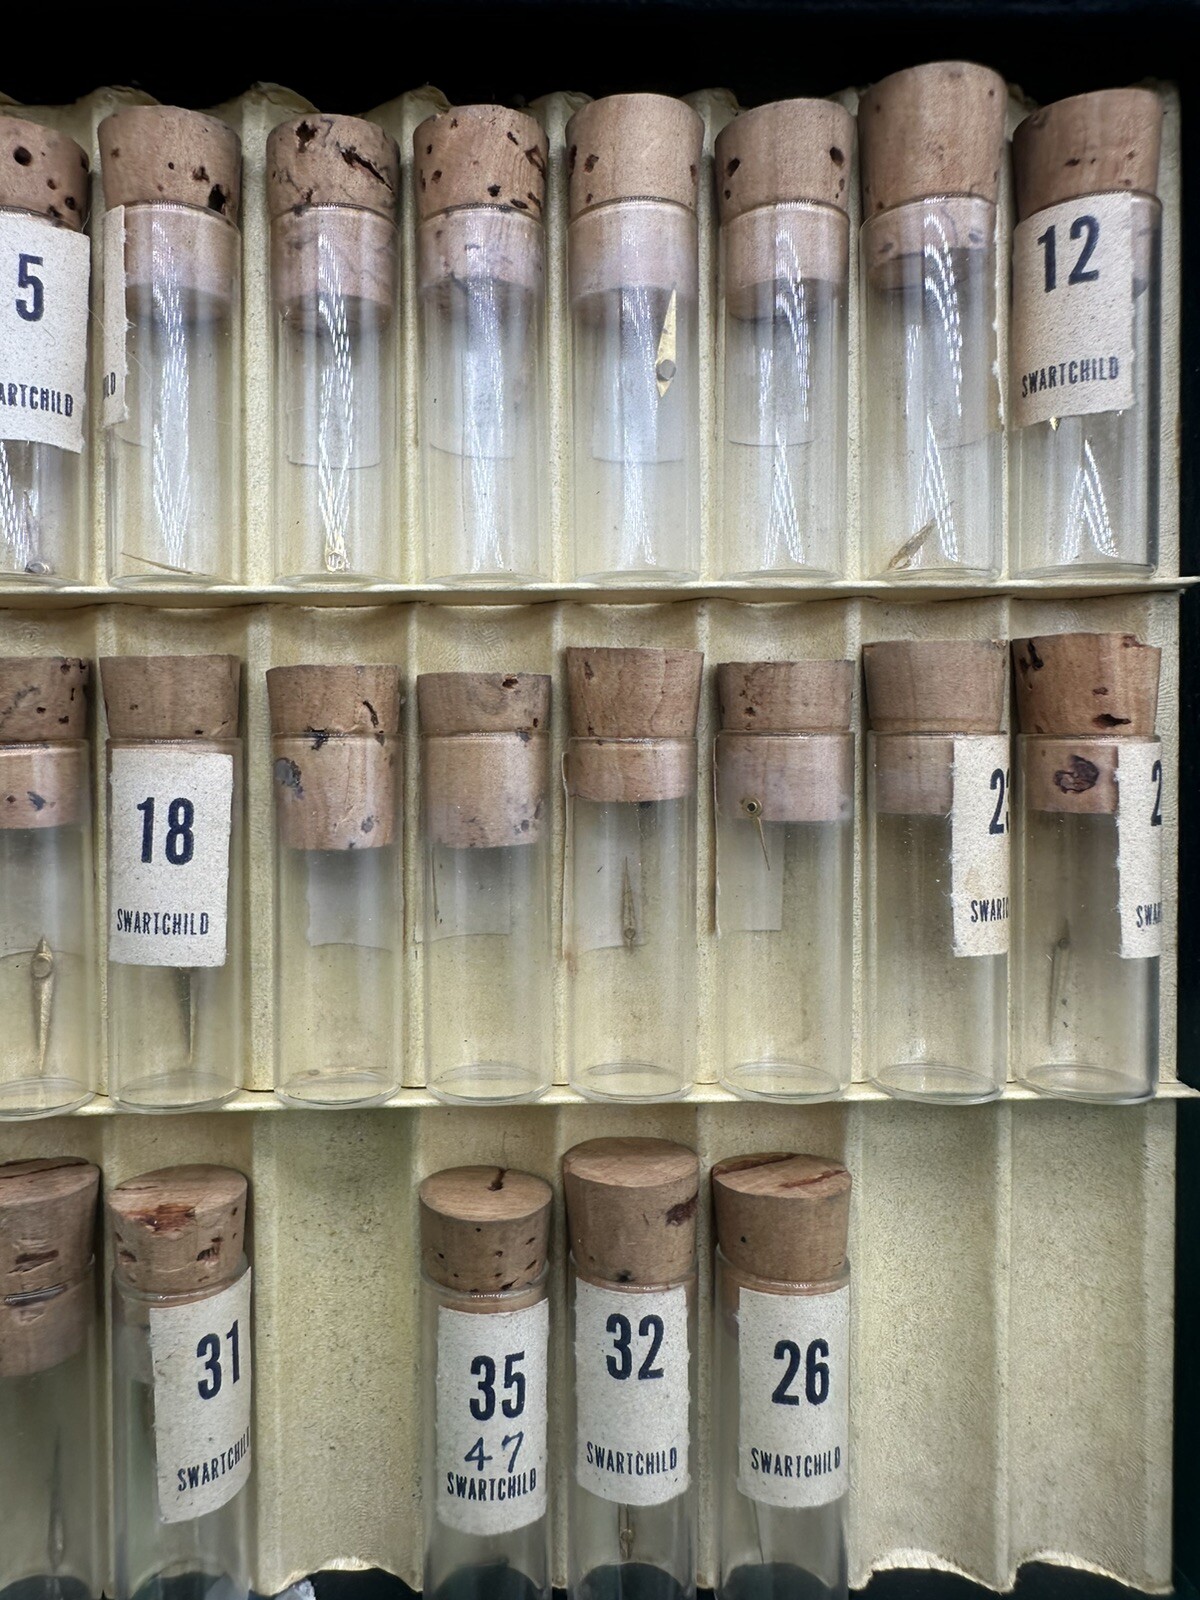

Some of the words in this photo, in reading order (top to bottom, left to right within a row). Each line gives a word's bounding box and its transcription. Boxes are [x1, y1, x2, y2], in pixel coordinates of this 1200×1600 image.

[15, 253, 45, 322] 5
[1037, 214, 1101, 294] 12
[1021, 355, 1120, 398] SWARTCHILD
[136, 796, 195, 865] 18
[988, 767, 1009, 835] 2
[116, 907, 210, 936] SWARTCHILD
[196, 1319, 241, 1401] 31
[605, 1312, 665, 1381] 32
[771, 1337, 830, 1406] 26
[469, 1350, 527, 1421] 35
[446, 1467, 537, 1502] SWARTCHILD
[586, 1441, 678, 1476] SWARTCHILD
[750, 1445, 841, 1479] SWARTCHILD
